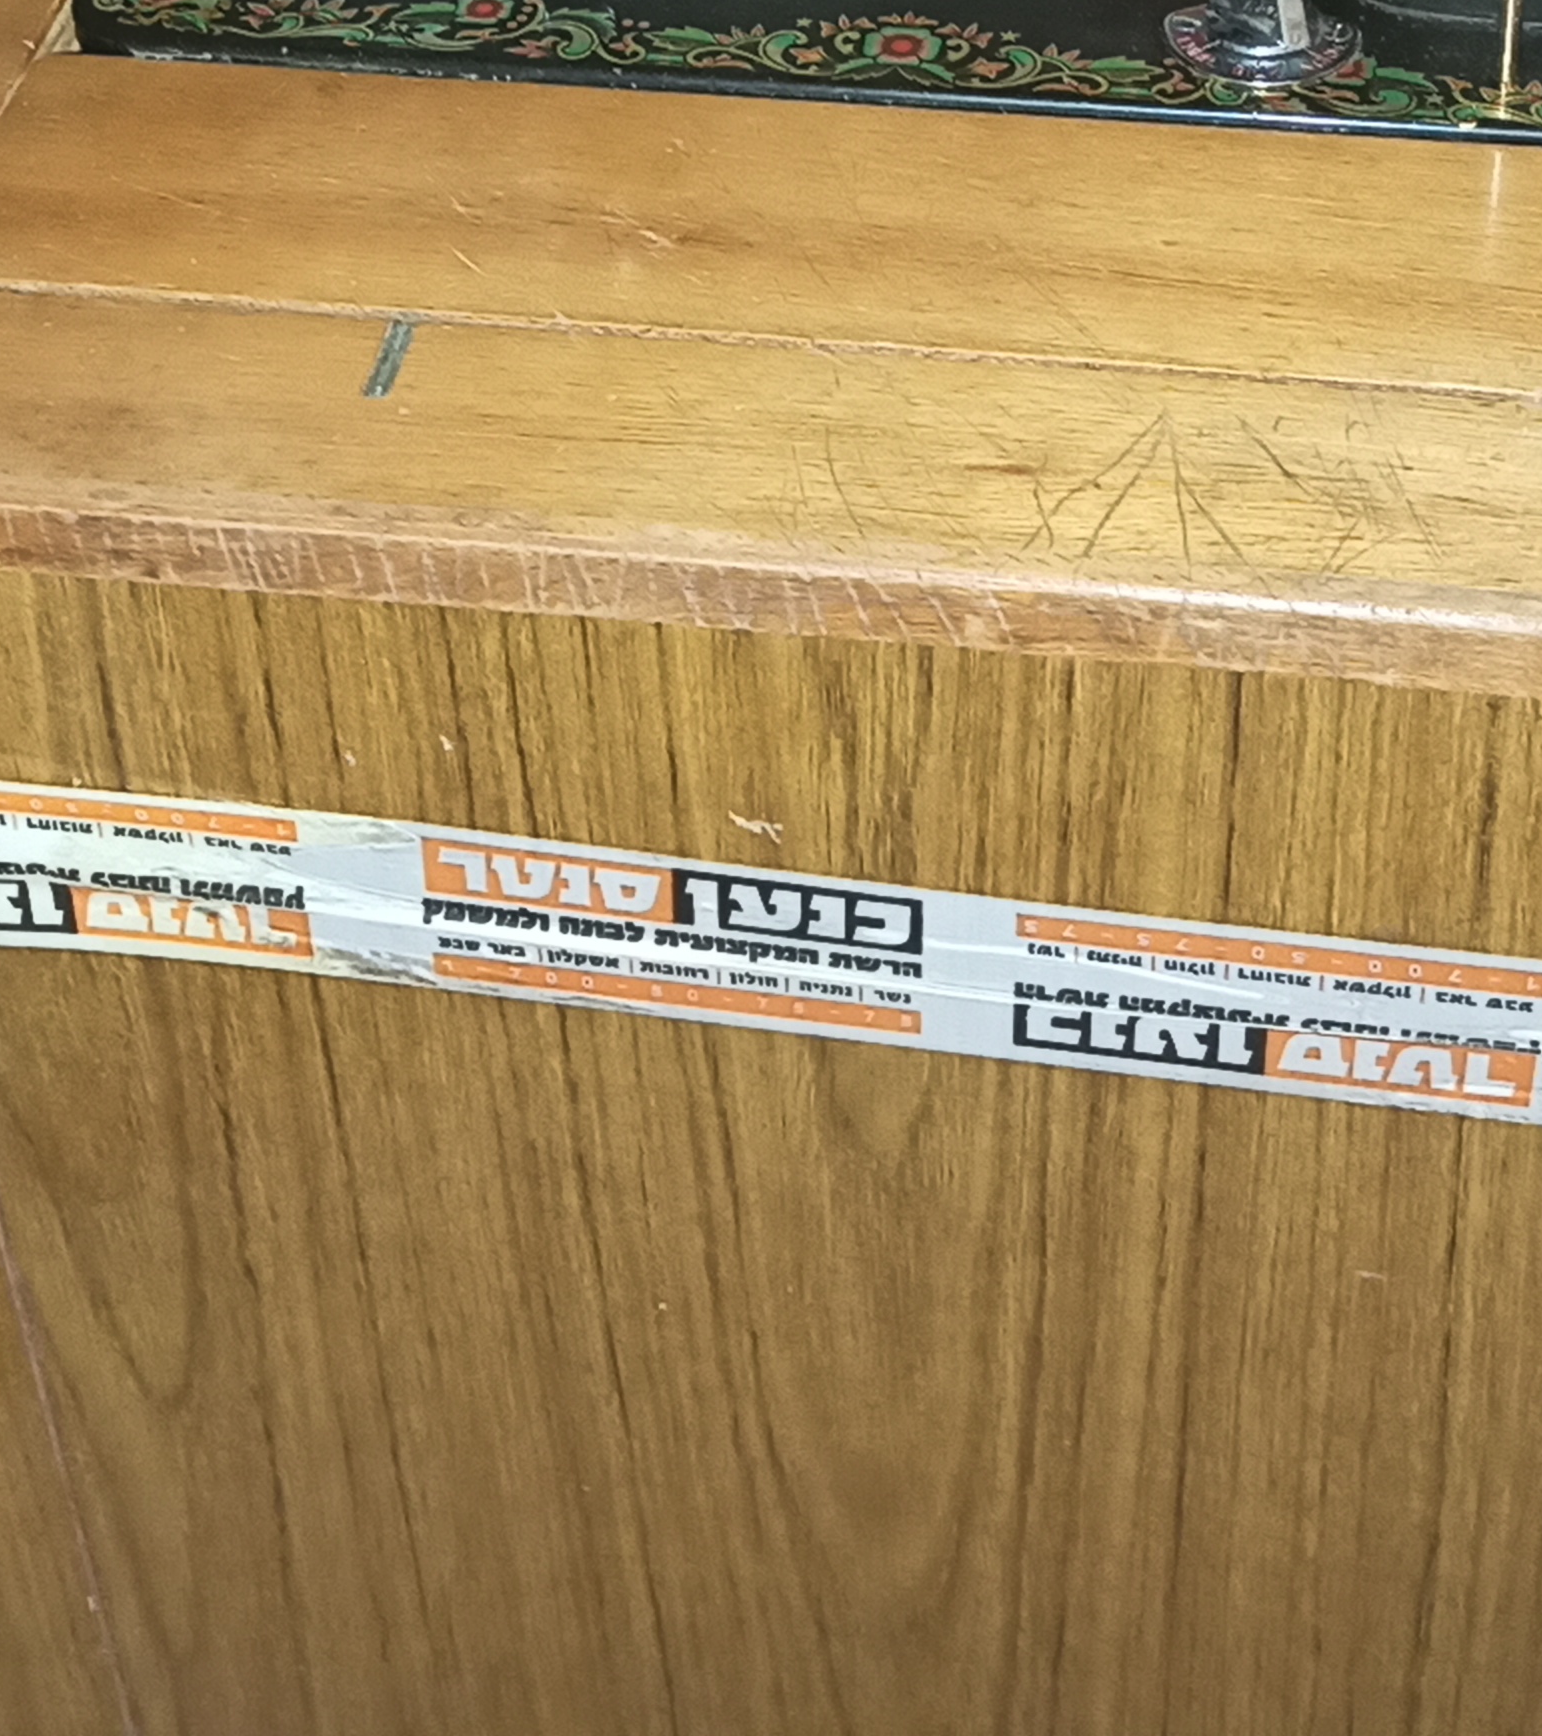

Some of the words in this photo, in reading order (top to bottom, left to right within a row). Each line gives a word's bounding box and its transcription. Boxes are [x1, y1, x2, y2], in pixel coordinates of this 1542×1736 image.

[26, 817, 94, 835] רחובות
[112, 824, 184, 844] אשקלון
[203, 835, 244, 851] באר
[437, 846, 662, 913] סנטר
[684, 877, 912, 946] כנען
[487, 941, 527, 958] באר
[547, 948, 620, 969] אשקלון
[654, 927, 820, 965] המקצועית
[639, 960, 709, 980] רחובות
[828, 951, 923, 978] הרשת
[1026, 942, 1066, 959] נשר
[1086, 949, 1143, 967] נתניה
[1163, 959, 1216, 976] חולון
[1237, 967, 1312, 988] רחובות
[1332, 977, 1412, 1000] אשקלון
[1434, 990, 1478, 1007] באר
[1485, 997, 1535, 1014] שבע
[728, 970, 779, 991] חולון
[799, 978, 854, 997] נתניה
[873, 987, 912, 1004] נשר
[1012, 981, 1111, 1009] הרשת
[1025, 1006, 1253, 1066] כנען
[1277, 1034, 1517, 1098] סנטר
